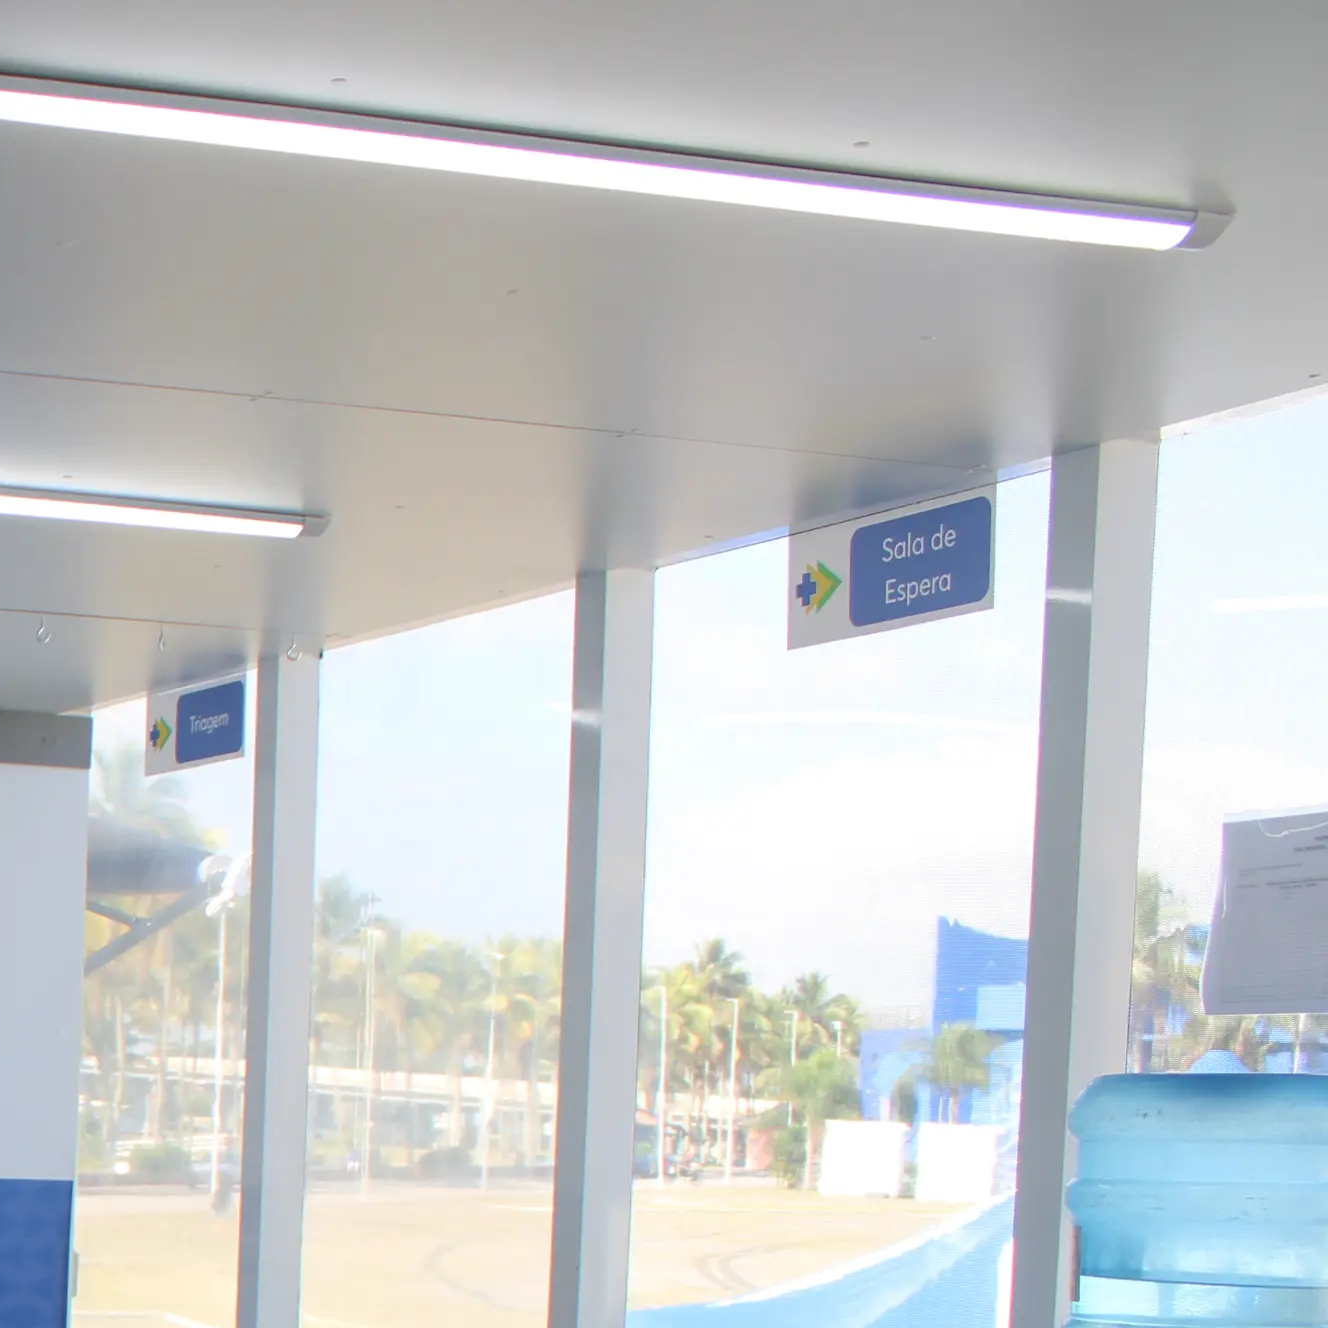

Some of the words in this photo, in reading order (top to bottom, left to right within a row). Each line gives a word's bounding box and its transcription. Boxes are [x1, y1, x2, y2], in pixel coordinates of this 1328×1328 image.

[881, 530, 924, 562] Sala
[931, 523, 956, 550] de
[885, 571, 951, 605] Espera
[189, 712, 229, 734] Triagem
